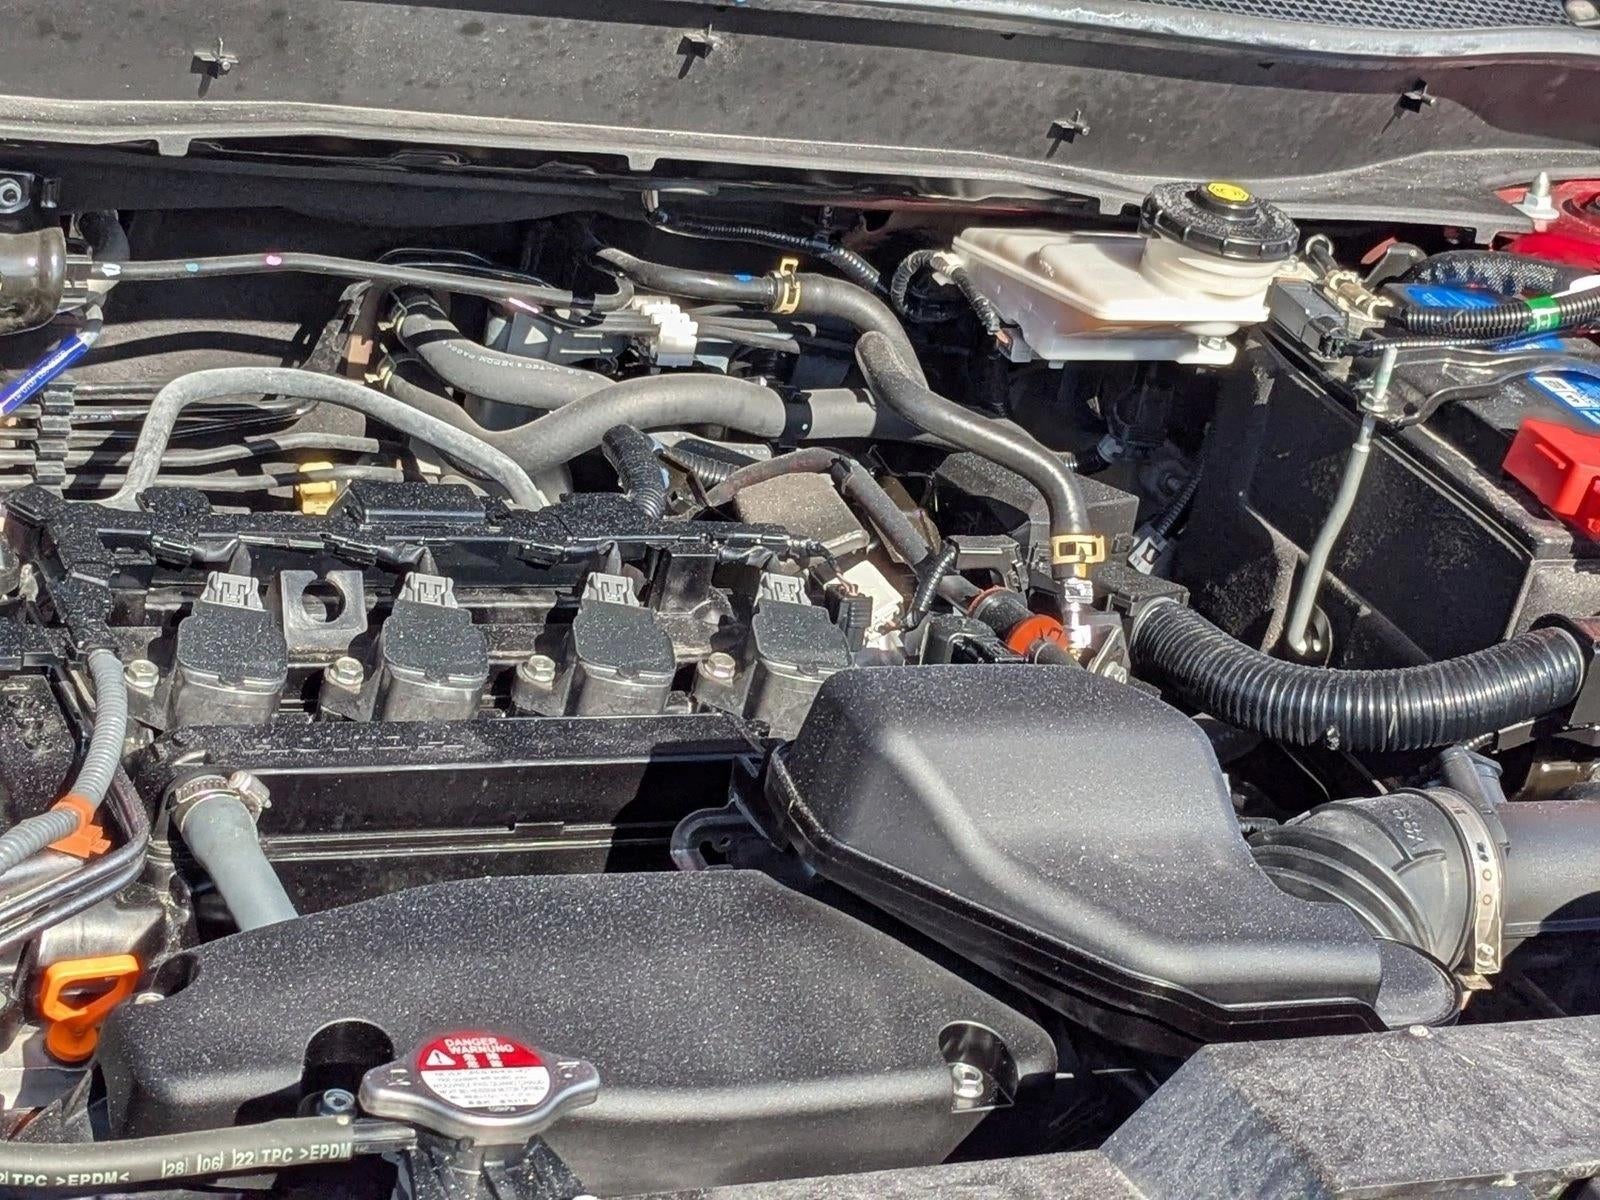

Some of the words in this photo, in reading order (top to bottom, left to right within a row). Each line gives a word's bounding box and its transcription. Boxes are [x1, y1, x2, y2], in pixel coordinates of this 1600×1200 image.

[444, 1037, 498, 1048] DANGER
[261, 1147, 293, 1163] TPC
[12, 1173, 48, 1186] TPC
[56, 1171, 130, 1186] >EPDM<
